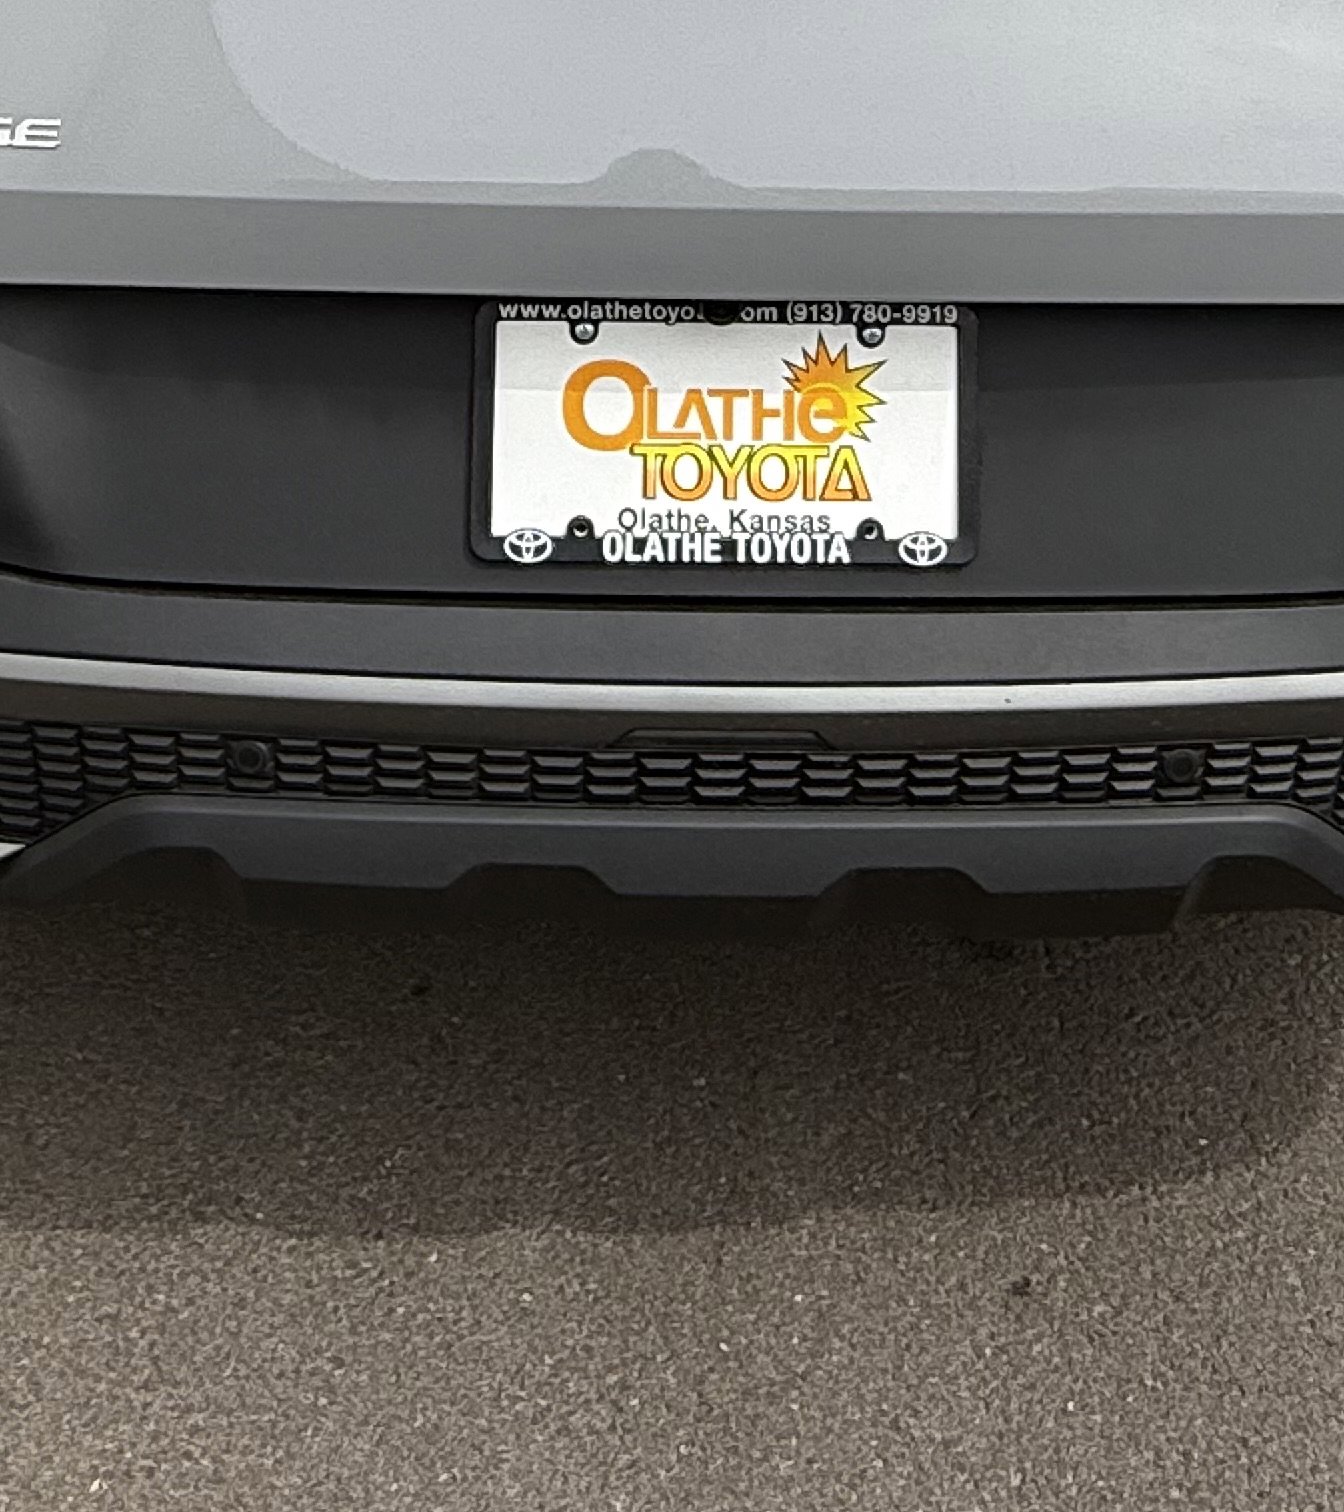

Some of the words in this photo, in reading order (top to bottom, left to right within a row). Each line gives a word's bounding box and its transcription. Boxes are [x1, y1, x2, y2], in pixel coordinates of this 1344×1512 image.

[498, 300, 778, 324] www.olathetoyoom
[786, 301, 843, 324] (913)
[849, 303, 958, 324] 780-9919
[630, 443, 872, 502] TOYOTA
[729, 508, 831, 533] Kansas
[602, 530, 722, 564] OLATHE
[731, 531, 852, 564] TOYOTA
